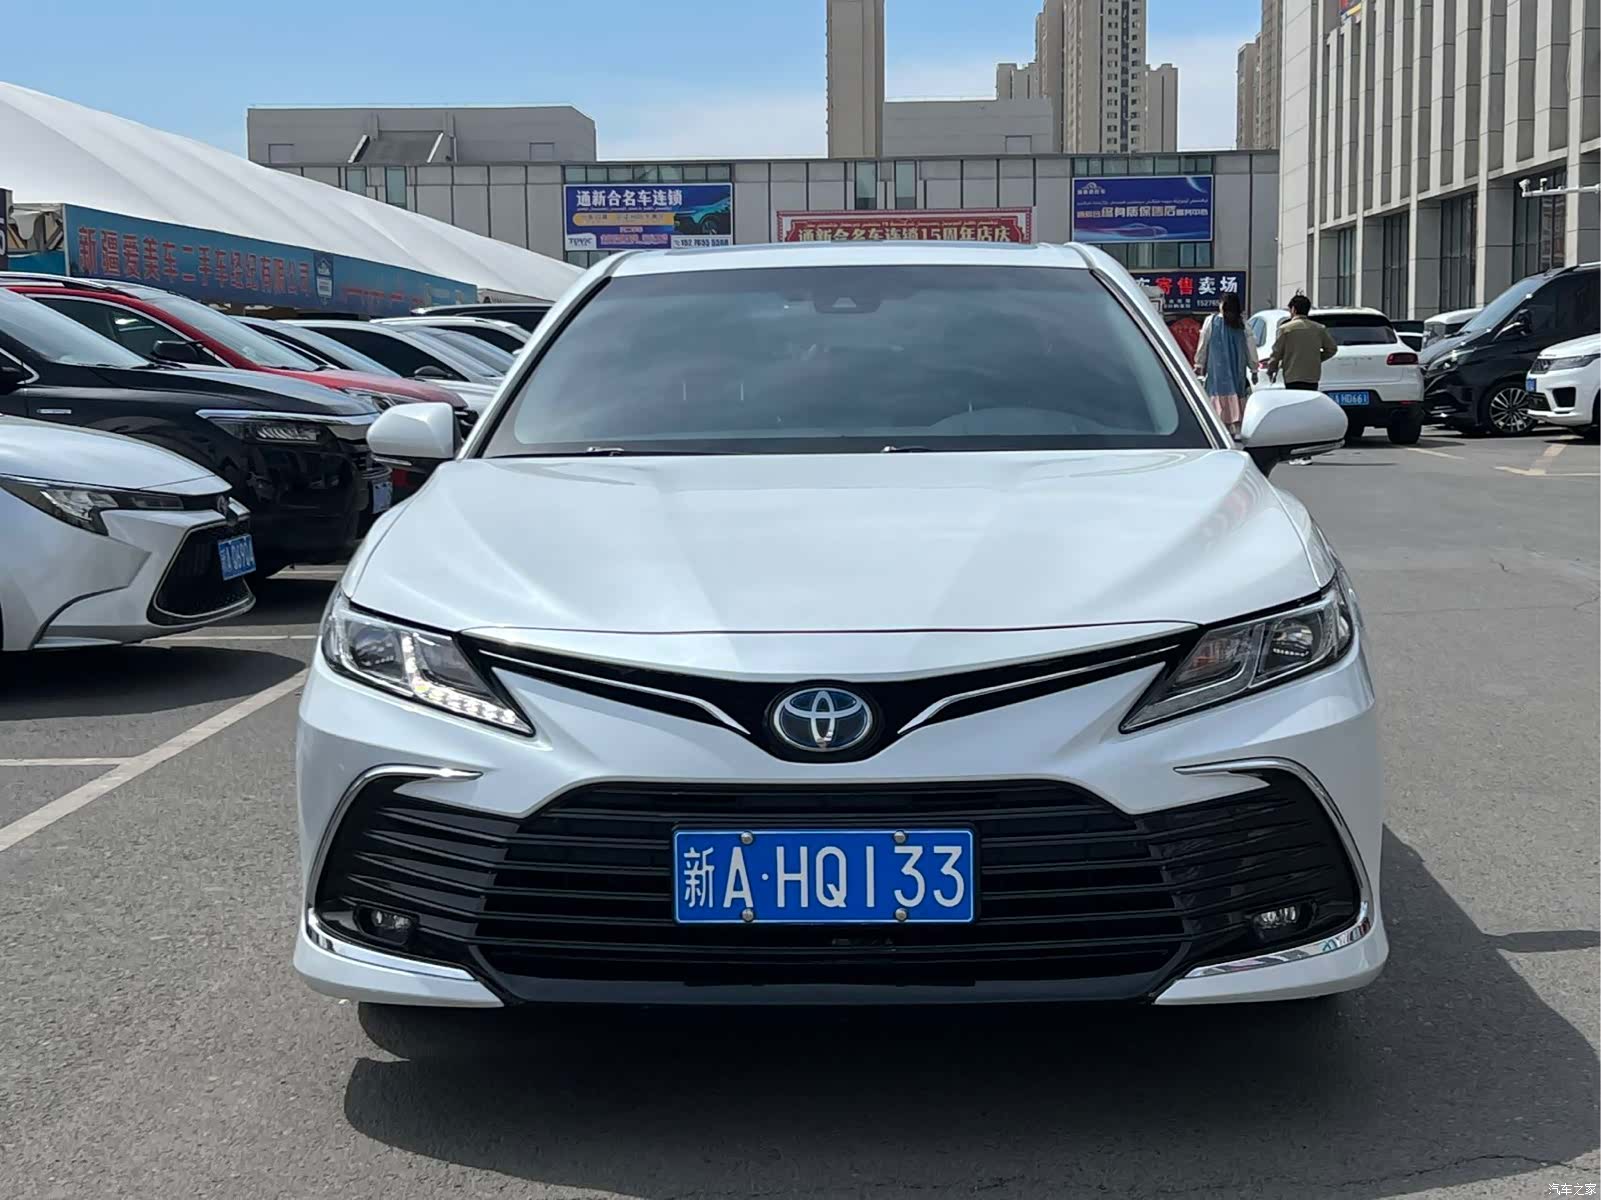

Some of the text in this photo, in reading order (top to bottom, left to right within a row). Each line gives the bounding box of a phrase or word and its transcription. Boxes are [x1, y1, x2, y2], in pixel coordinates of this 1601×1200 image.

[576, 189, 683, 207] 通新合名车连锁
[799, 226, 1011, 242] 通新合名车连锁15周年店庆
